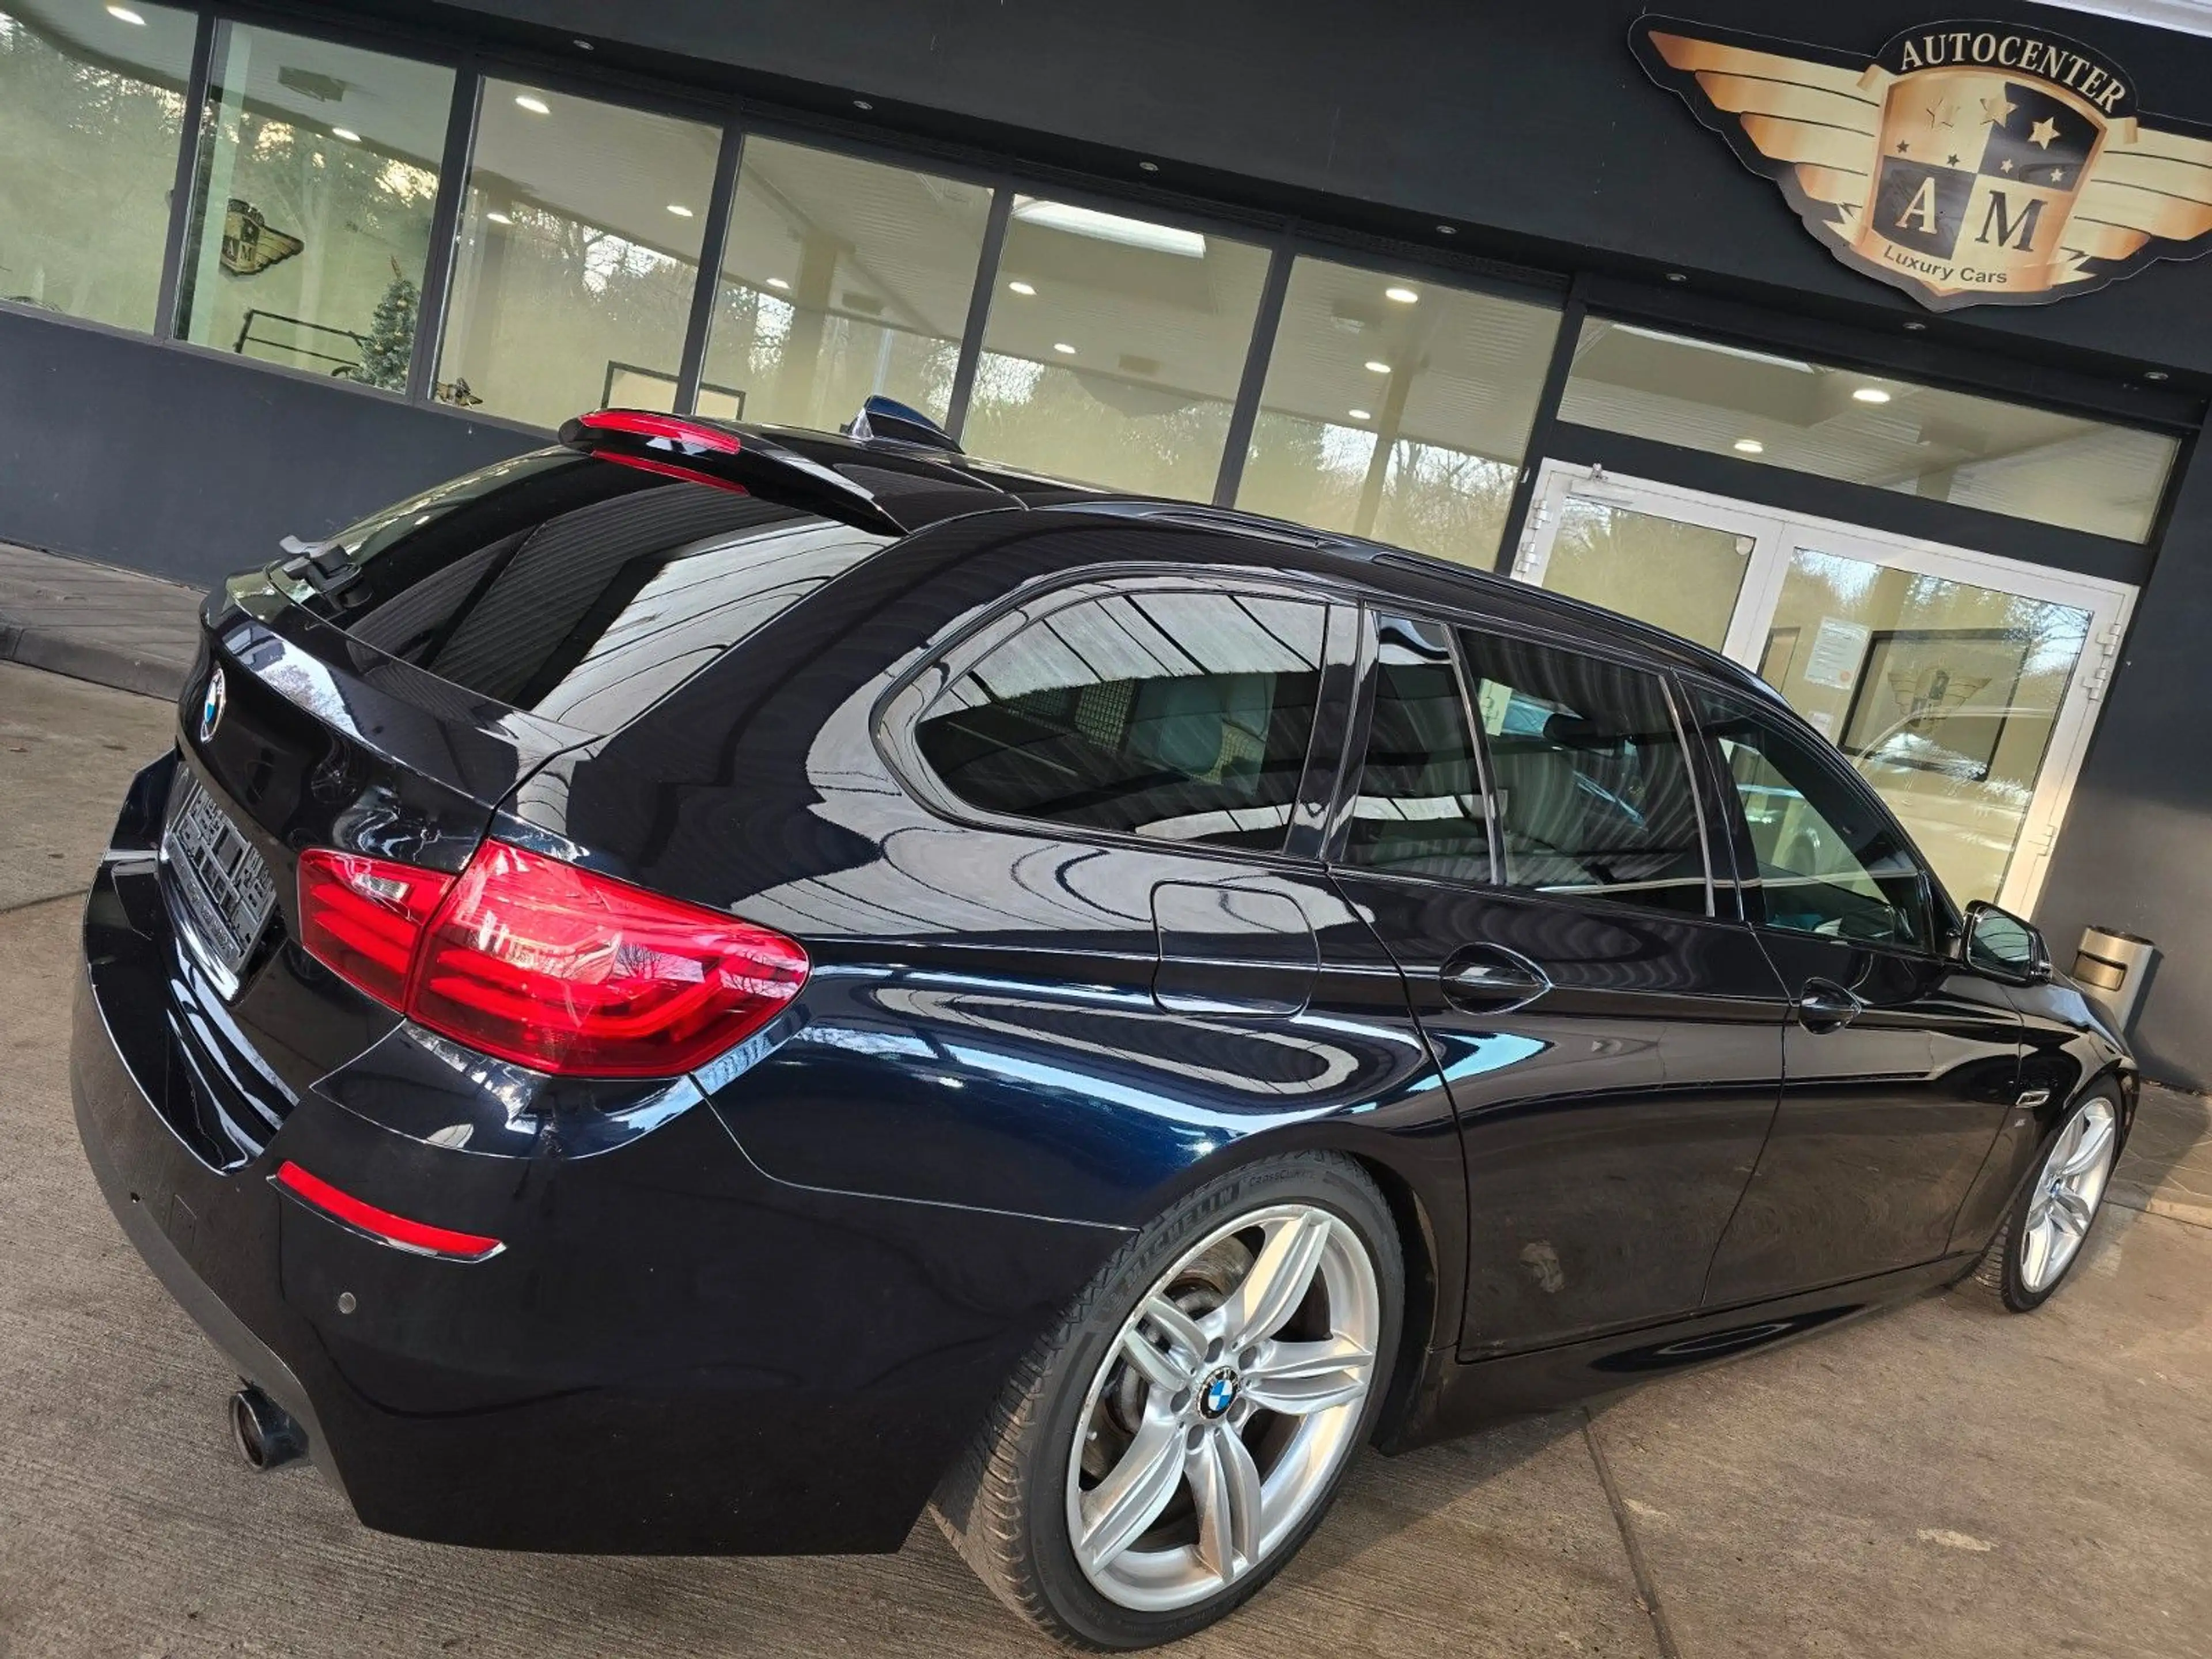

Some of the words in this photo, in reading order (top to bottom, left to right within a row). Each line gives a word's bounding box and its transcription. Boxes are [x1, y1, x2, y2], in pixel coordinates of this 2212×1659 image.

[1901, 33, 2126, 113] AUTOCENTER
[1895, 176, 1937, 234] A
[1975, 189, 2048, 252] M
[1884, 244, 1955, 281] Luxury
[1960, 267, 2008, 283] Cars
